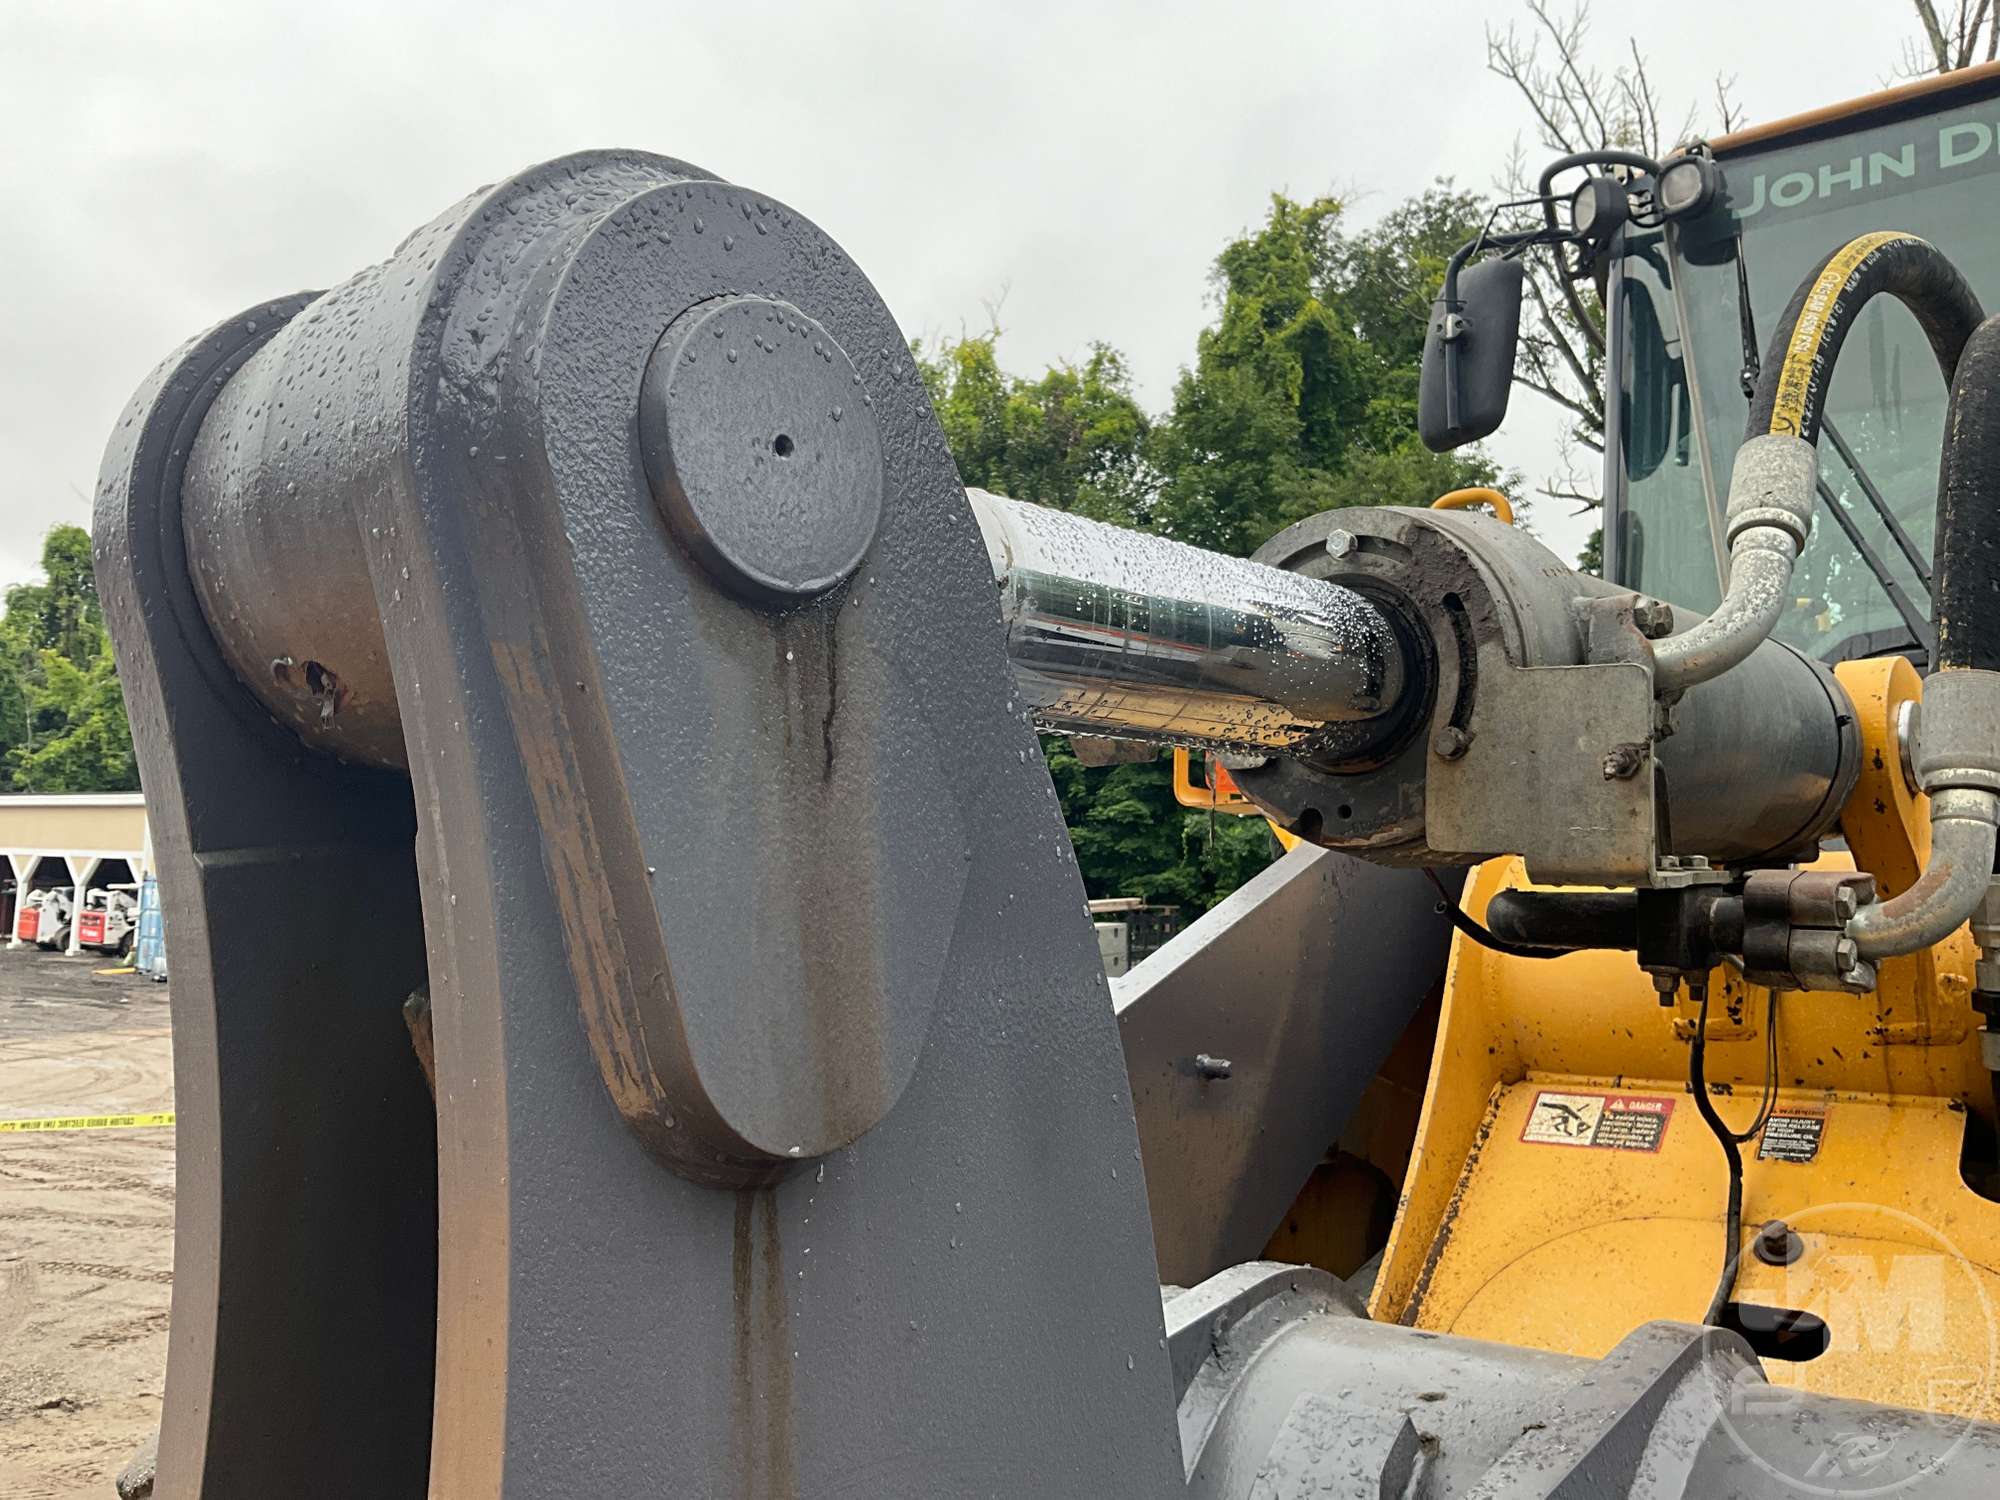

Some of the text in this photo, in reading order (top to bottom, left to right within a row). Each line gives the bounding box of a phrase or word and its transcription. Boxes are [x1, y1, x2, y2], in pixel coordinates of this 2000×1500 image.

[1731, 121, 2000, 220] JOHN D
[1628, 1101, 1663, 1111] DANGER
